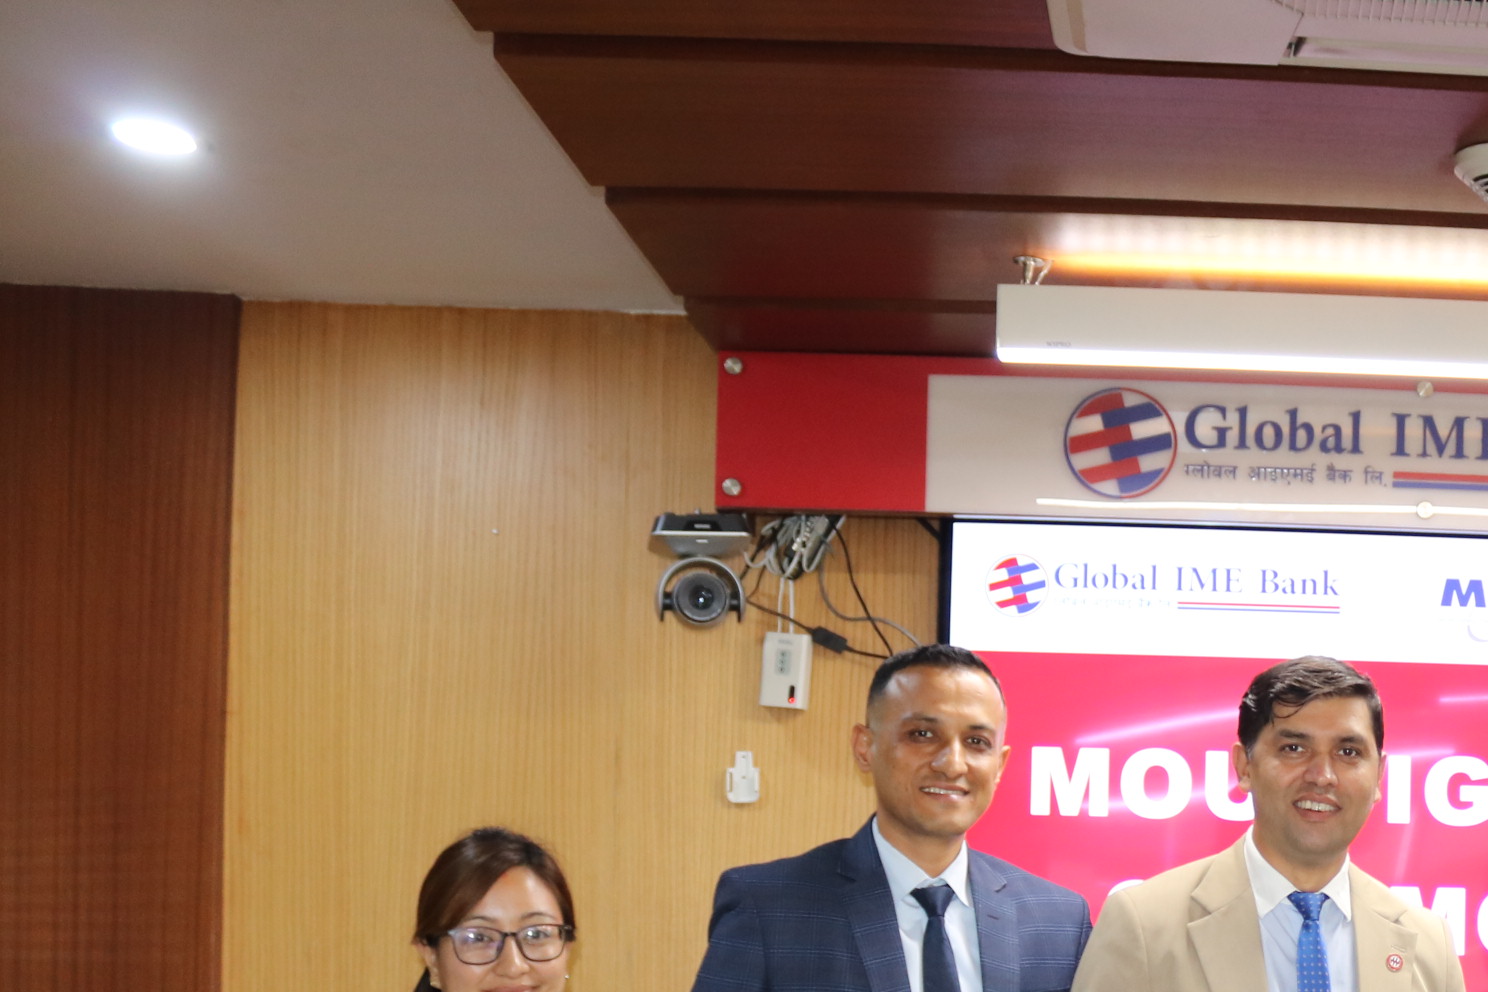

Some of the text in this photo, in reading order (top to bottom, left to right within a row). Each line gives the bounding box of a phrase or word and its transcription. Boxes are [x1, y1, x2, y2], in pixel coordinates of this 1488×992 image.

[1184, 404, 1364, 456] Global
[1054, 563, 1340, 596] Global IME Bank
